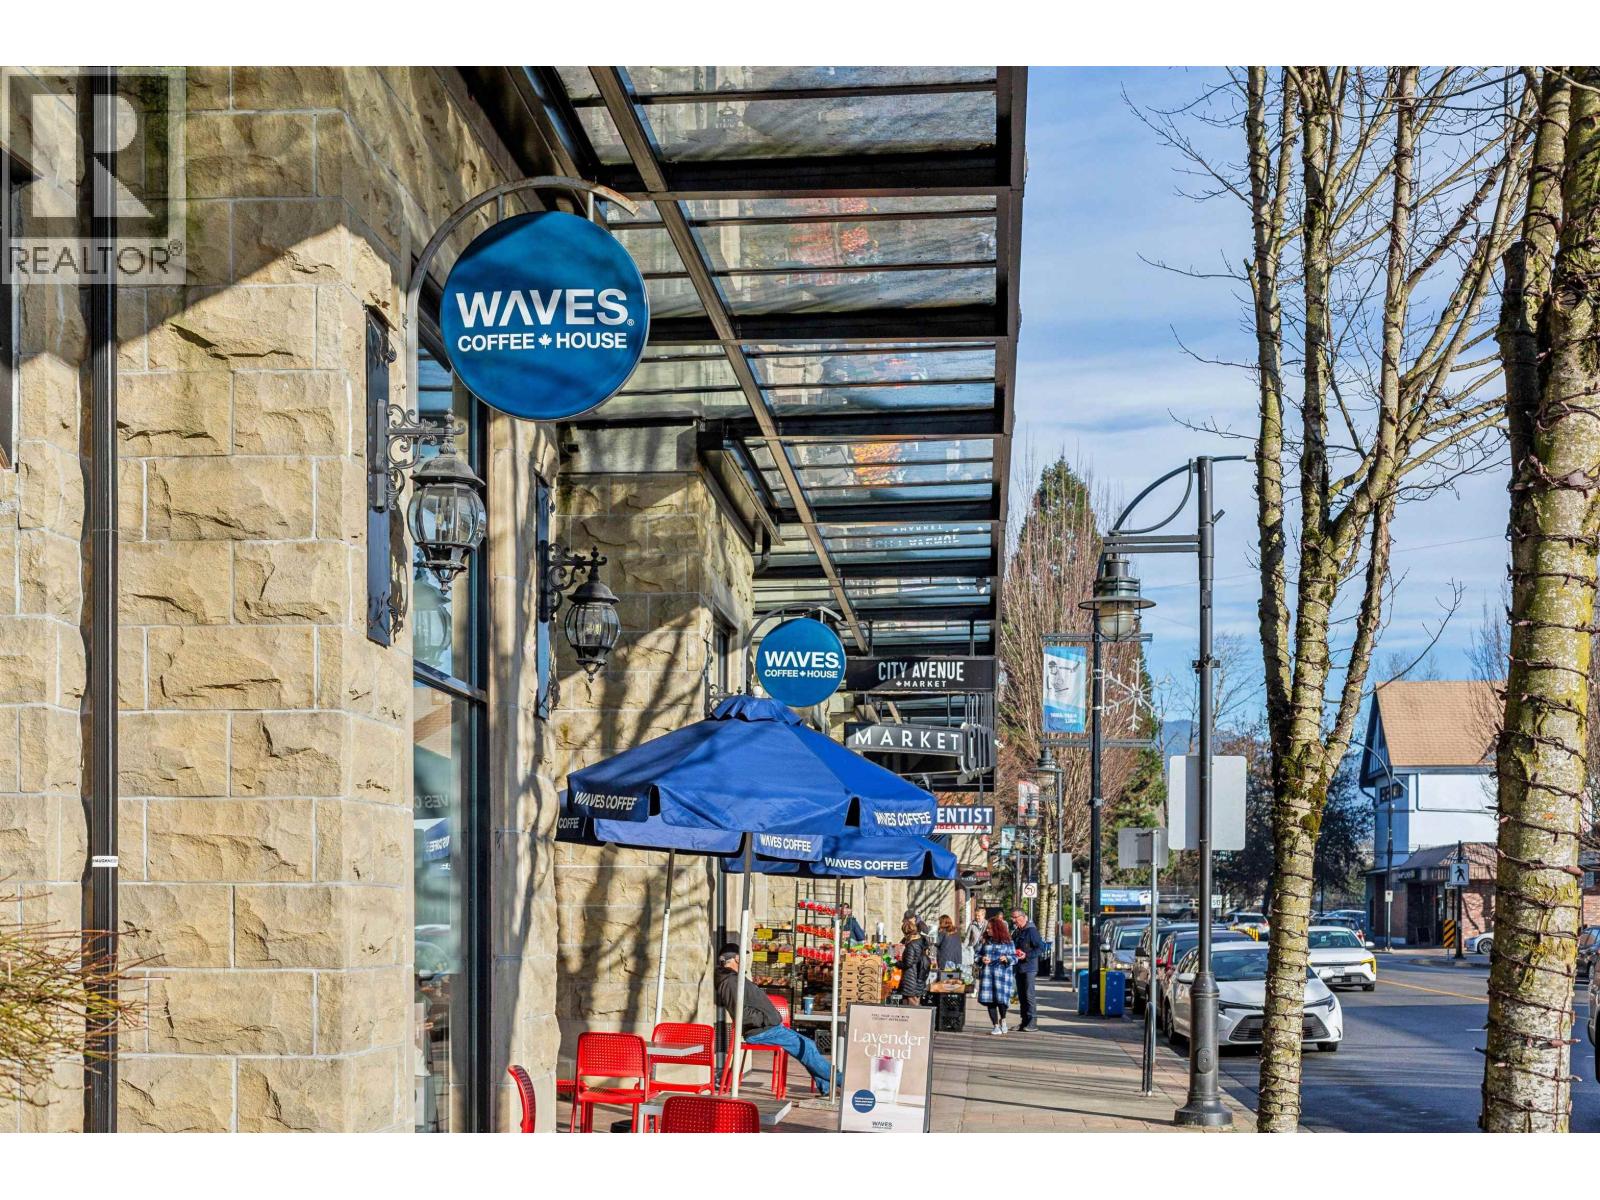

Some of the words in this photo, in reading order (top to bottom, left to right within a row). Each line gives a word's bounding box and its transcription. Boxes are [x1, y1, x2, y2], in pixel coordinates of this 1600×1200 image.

[457, 333, 535, 352] COFFEE
[556, 332, 628, 349] HOUSE
[764, 669, 798, 678] COFFEE
[807, 670, 838, 679] HOUSE
[878, 661, 907, 681] CITY
[912, 661, 965, 681] AVENUE
[903, 680, 947, 688] MARKET
[855, 728, 959, 751] MARKET
[574, 791, 605, 808] WAVES
[897, 811, 932, 827] COFFEE
[937, 807, 993, 823] ENTIST
[760, 833, 782, 849] WAVES
[783, 838, 812, 853] COFFEE
[825, 857, 862, 870] WAVES
[863, 860, 909, 871] COFFEE
[853, 1029, 929, 1046] Lavender
[864, 1043, 912, 1060] Cloud
